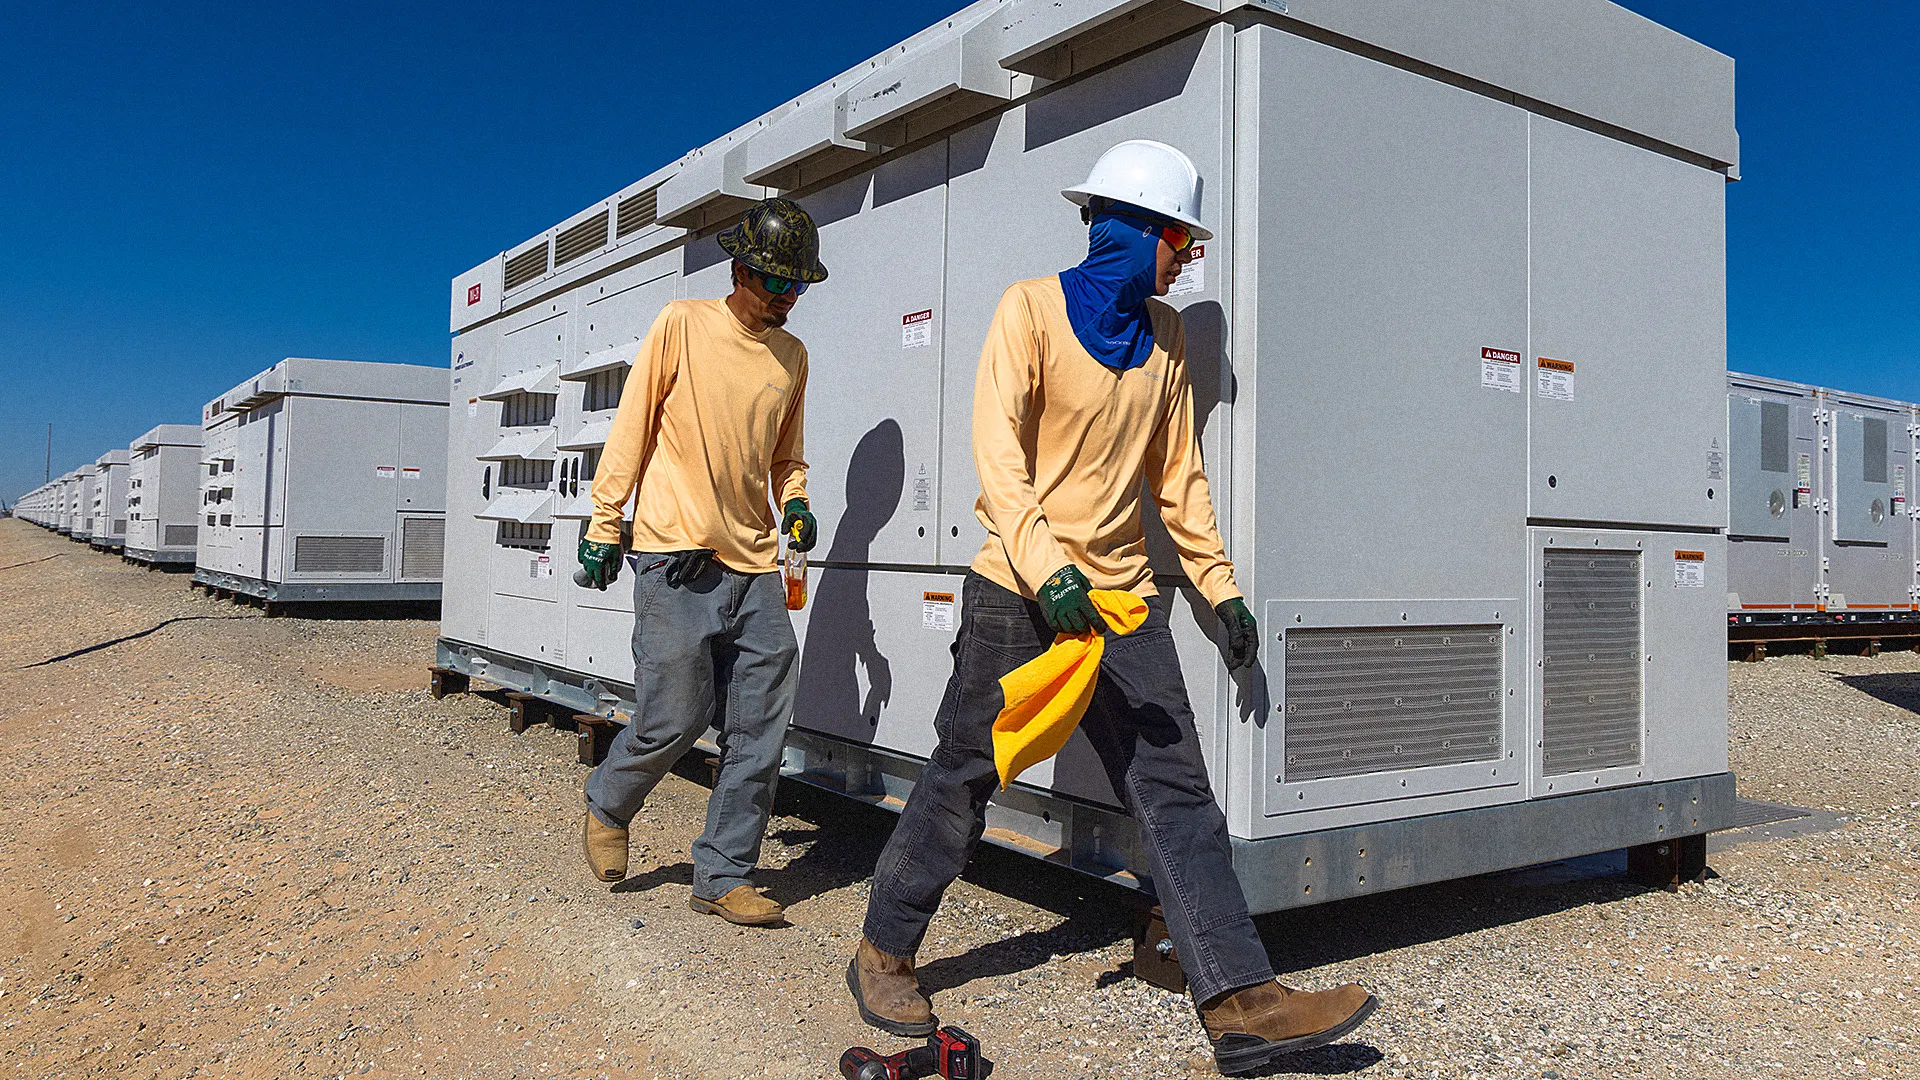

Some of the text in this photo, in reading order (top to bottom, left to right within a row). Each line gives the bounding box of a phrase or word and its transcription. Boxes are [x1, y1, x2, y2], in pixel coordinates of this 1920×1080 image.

[910, 311, 930, 323] DANGER
[1492, 351, 1518, 362] DANGER
[1546, 361, 1572, 372] WARNING
[1051, 583, 1079, 602] MaxiFlex
[930, 594, 952, 603] WARNING
